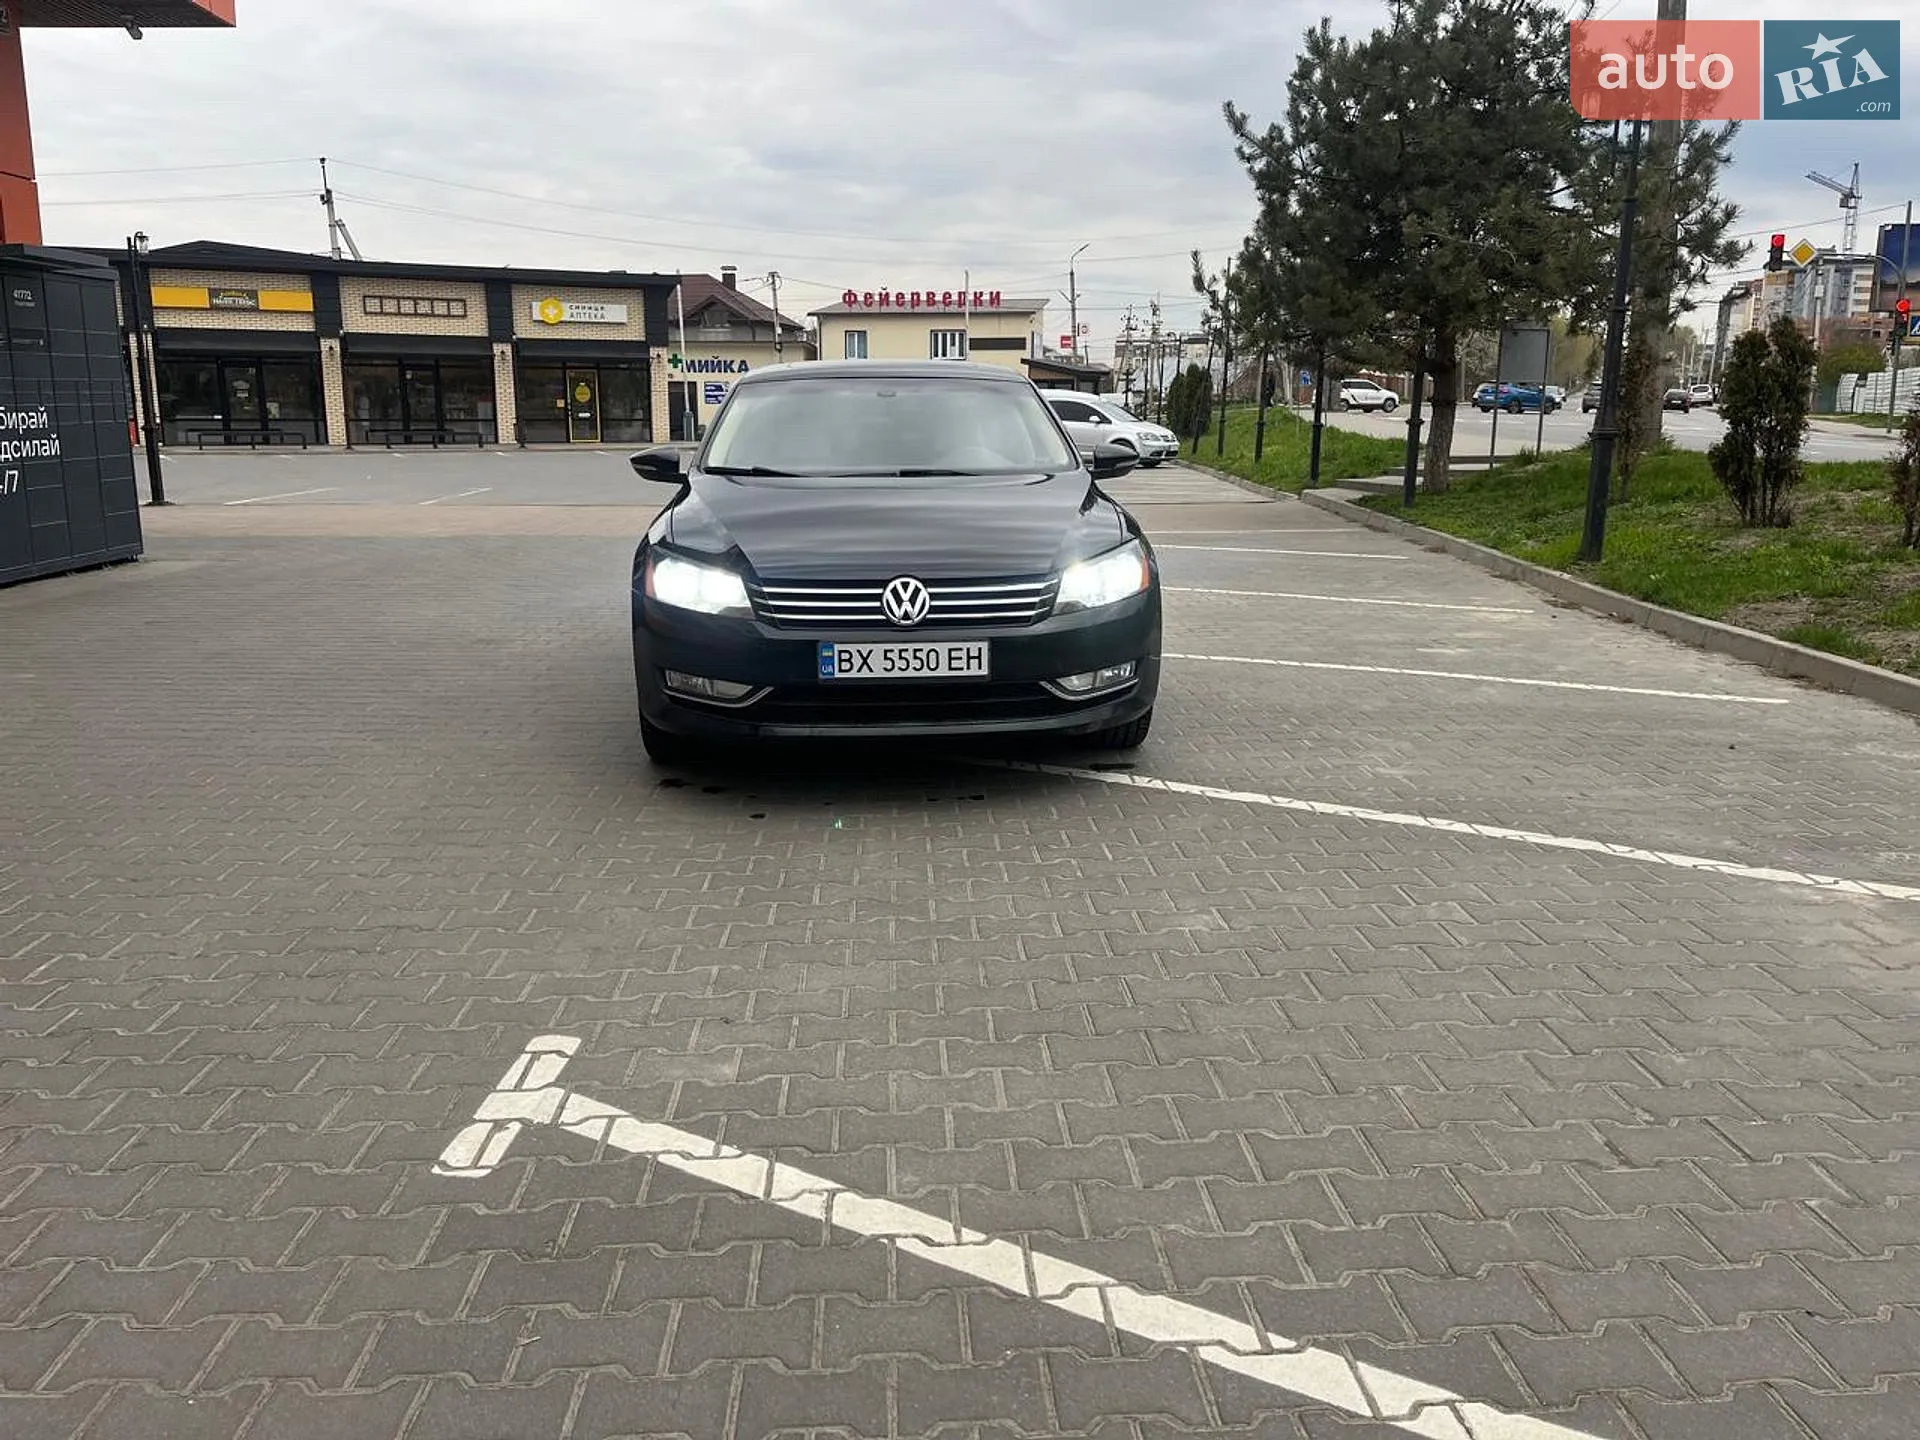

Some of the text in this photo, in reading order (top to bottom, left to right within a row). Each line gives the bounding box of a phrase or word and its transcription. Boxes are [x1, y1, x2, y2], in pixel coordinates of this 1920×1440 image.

[681, 355, 750, 373] МИЙКА
[0, 469, 18, 495] /7
[838, 646, 983, 673] BX 5550 EH
